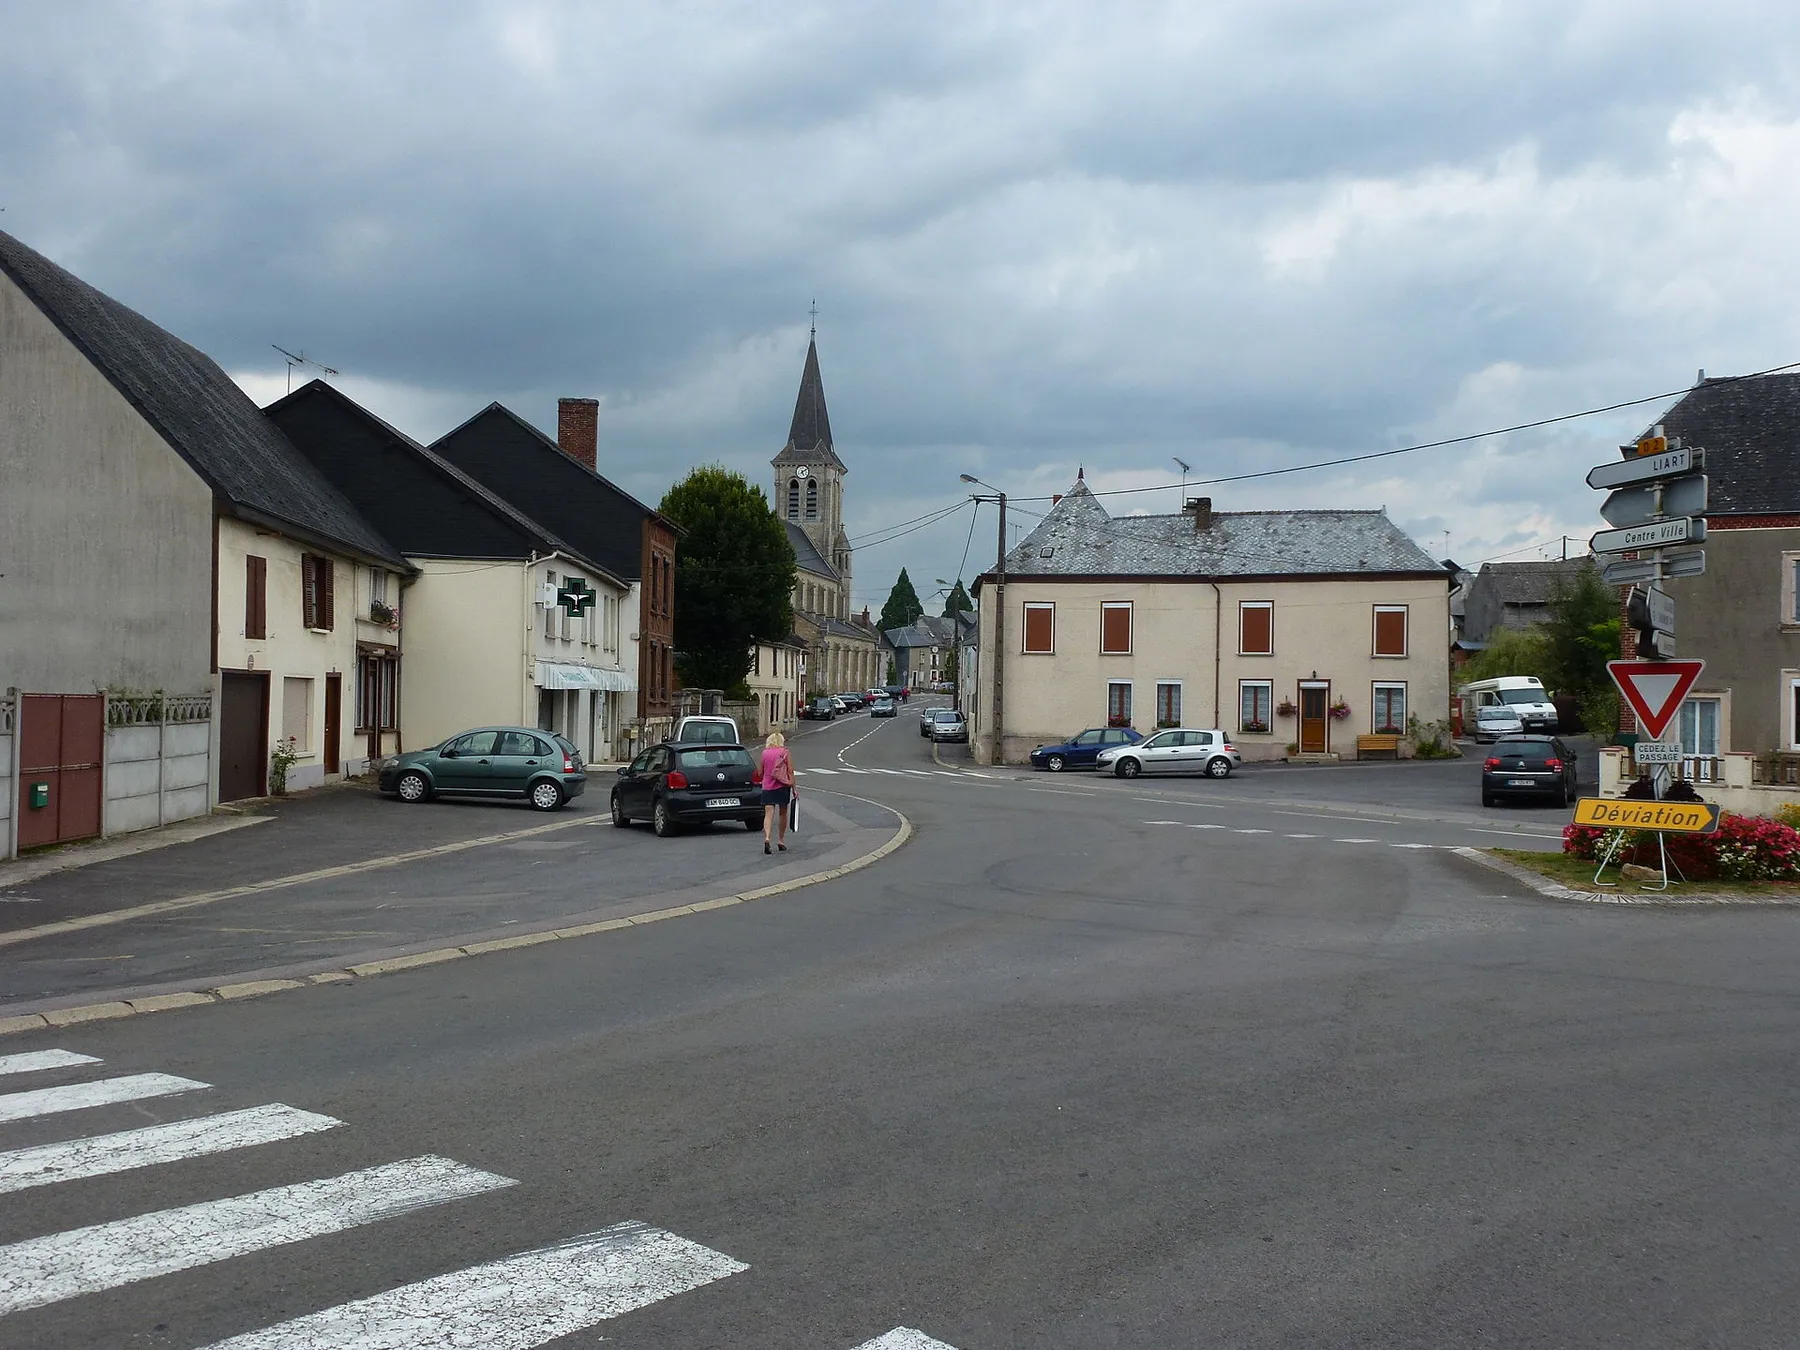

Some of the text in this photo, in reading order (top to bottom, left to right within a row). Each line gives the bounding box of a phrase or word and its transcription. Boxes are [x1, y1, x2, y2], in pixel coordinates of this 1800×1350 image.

[1654, 454, 1684, 471] LIART
[1625, 524, 1683, 543] Centre Ville
[1591, 804, 1699, 826] Déviation
